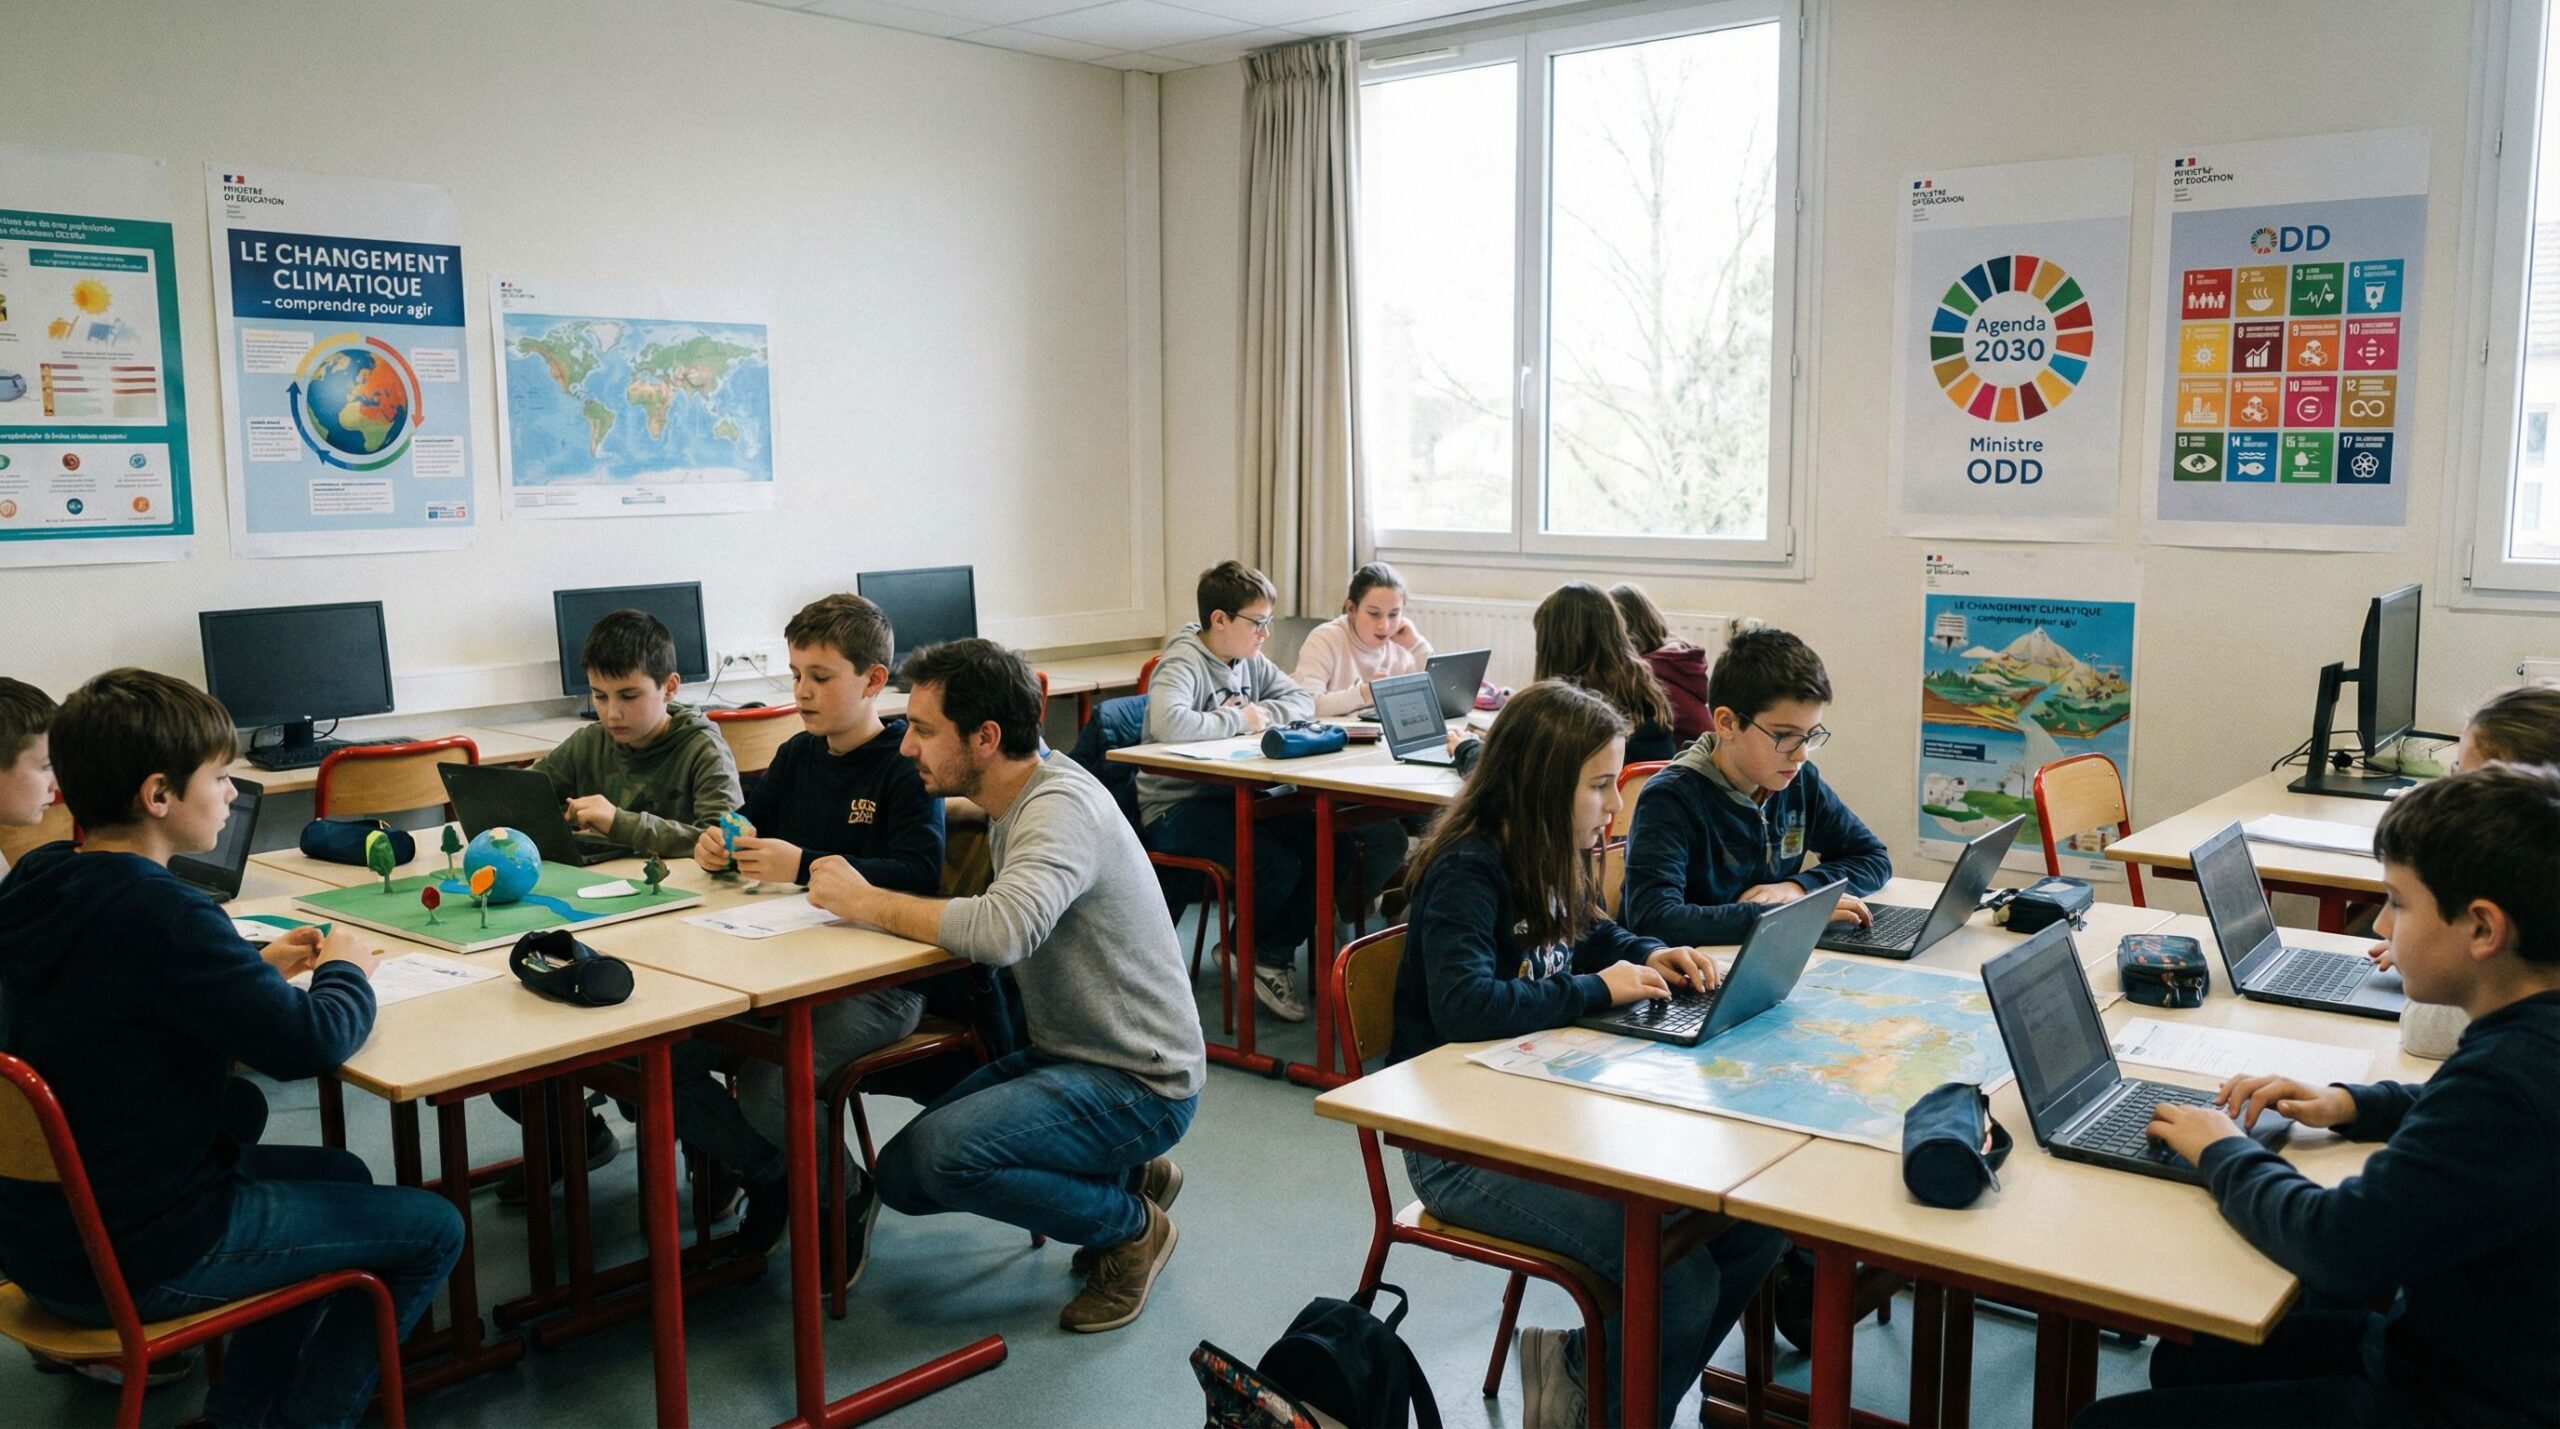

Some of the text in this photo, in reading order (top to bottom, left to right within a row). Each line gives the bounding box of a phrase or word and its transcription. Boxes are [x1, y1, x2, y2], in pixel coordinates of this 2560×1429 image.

[240, 241, 449, 274] LE CHANGEMENT
[2296, 268, 2303, 280] 3
[273, 269, 422, 299] CLIMATIQUE
[274, 298, 366, 314] comprendre
[370, 303, 403, 316] pour
[407, 302, 433, 319] agir
[1976, 315, 2045, 338] Agenda
[2238, 326, 2244, 338] 8
[2349, 322, 2360, 335] 10
[1974, 338, 2045, 362] 2030
[2289, 380, 2299, 392] 10
[2346, 379, 2357, 392] 12
[1970, 436, 2043, 452] Ministre
[2231, 435, 2240, 447] 14
[2343, 435, 2353, 448] 17
[1967, 458, 2043, 484] ODD
[1954, 600, 1964, 610] LE
